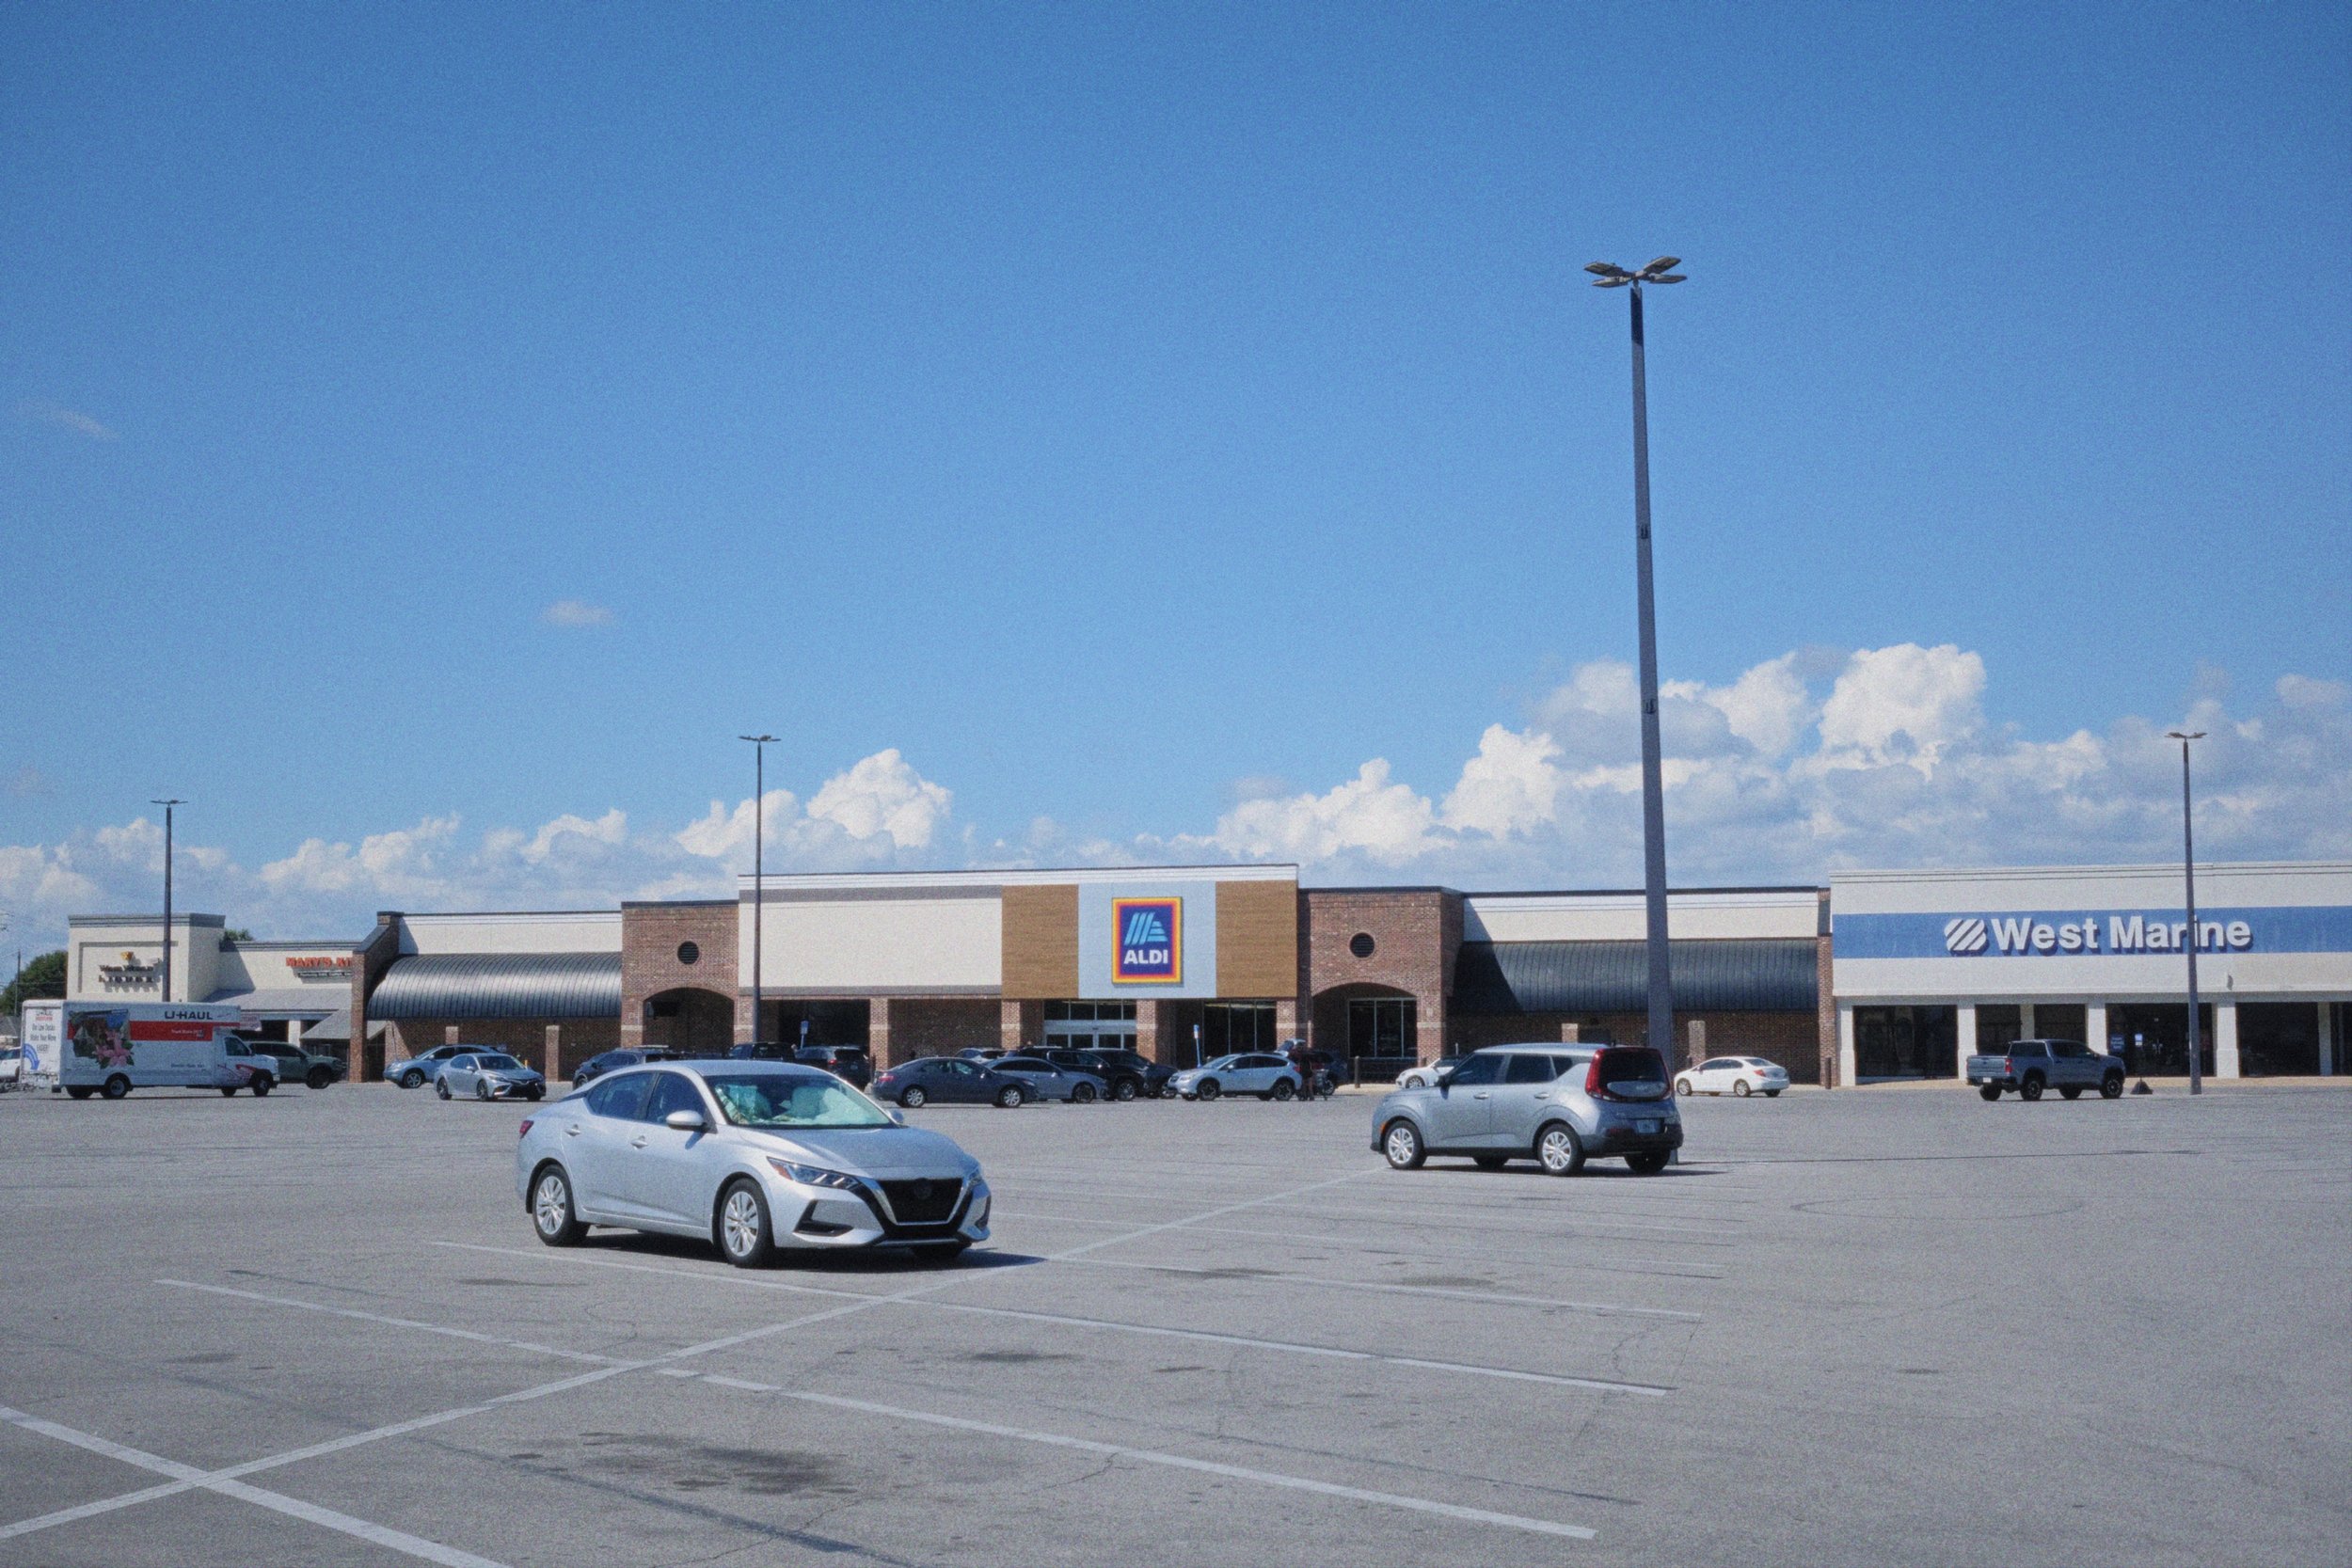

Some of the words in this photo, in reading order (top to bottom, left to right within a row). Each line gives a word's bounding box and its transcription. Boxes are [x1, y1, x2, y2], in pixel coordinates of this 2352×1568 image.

[1992, 918, 2097, 950] West
[286, 957, 332, 967] MARY'S
[1124, 949, 1168, 964] ALDI
[165, 1010, 213, 1020] U-HAUL
